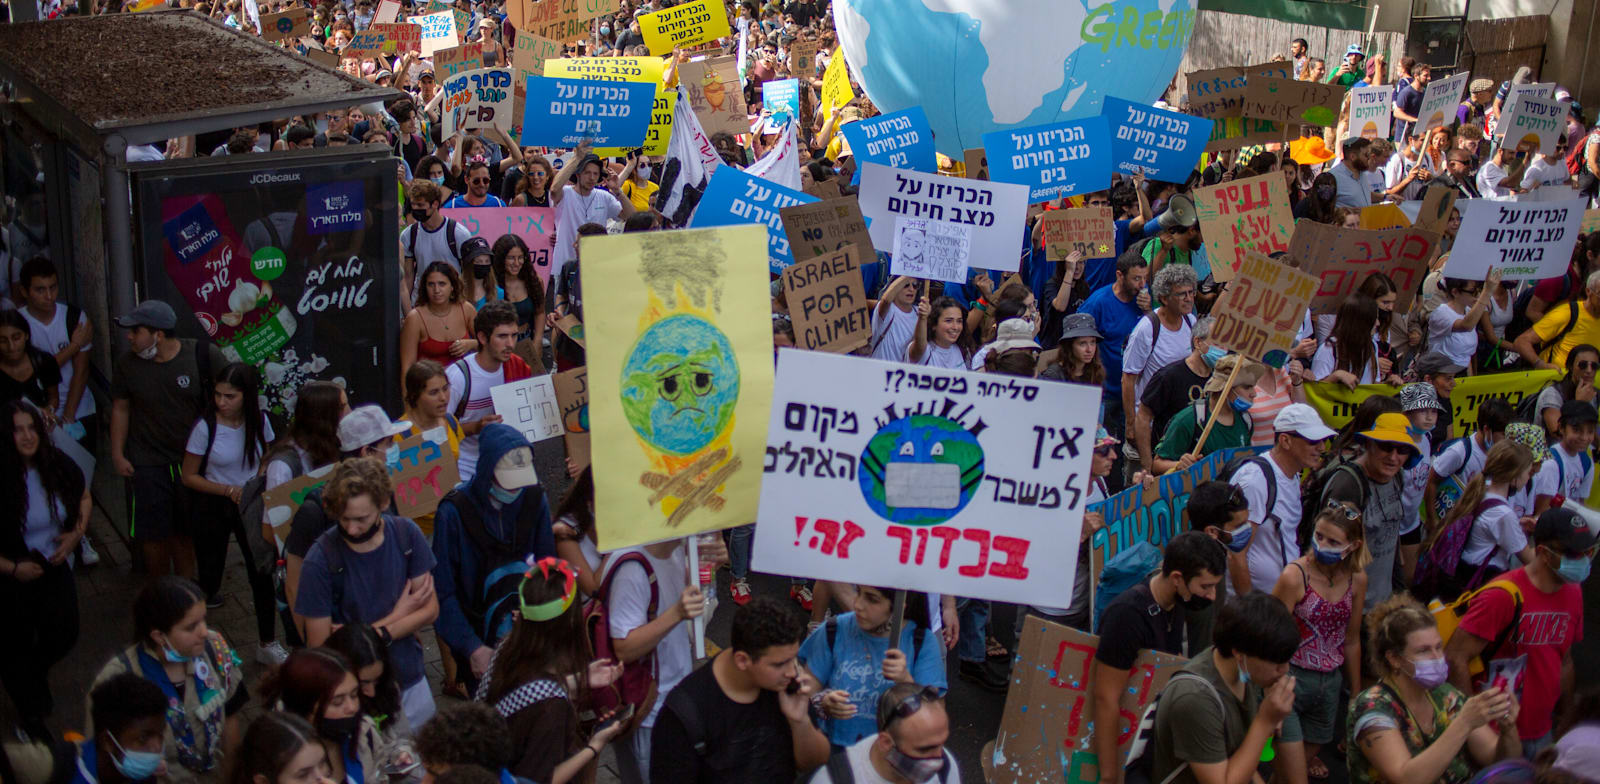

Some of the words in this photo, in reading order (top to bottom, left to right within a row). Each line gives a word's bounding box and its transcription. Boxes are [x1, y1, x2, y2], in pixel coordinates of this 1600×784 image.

[422, 15, 452, 25] SPEAK
[657, 11, 671, 23] על
[672, 4, 706, 20] הכריזו
[689, 13, 711, 26] מצב
[658, 20, 686, 34] חירום
[670, 27, 704, 42] ביבשה
[471, 70, 511, 89] כדור
[611, 67, 641, 75] מצב
[556, 81, 579, 99] על
[582, 86, 629, 101] הכריזו
[1432, 83, 1451, 96] עתיד
[1452, 79, 1462, 90] יש
[475, 88, 506, 103] יותר
[1358, 92, 1377, 103] עתיד
[1377, 91, 1387, 102] יש
[1426, 91, 1458, 111] לירוקים
[550, 101, 594, 116] חירום
[598, 103, 631, 117] מצב
[1127, 106, 1146, 125] על
[1356, 104, 1386, 119] לירוקים
[1524, 100, 1548, 115] עתיד
[1550, 105, 1562, 117] יש
[860, 124, 879, 139] על
[878, 116, 912, 135] הכריזו
[1149, 111, 1189, 135] הכריזו
[1516, 115, 1557, 132] לירוקים
[896, 131, 919, 148] מצב
[1011, 132, 1036, 150] על
[1038, 126, 1084, 148] הכריזו
[1116, 124, 1157, 146] חירום
[1159, 132, 1187, 151] מצב
[867, 136, 897, 156] חירום
[1059, 144, 1090, 162] מצב
[1133, 146, 1158, 163] בים
[889, 152, 908, 168] בים
[1011, 149, 1055, 169] חירום
[250, 173, 301, 185] JCDecaux
[896, 174, 922, 194] על
[1040, 167, 1067, 184] בים
[745, 179, 772, 201] על
[928, 182, 993, 206] הכריזו
[341, 211, 361, 222] מלח
[730, 198, 783, 231] חירום
[888, 196, 944, 221] חירום
[950, 206, 995, 227] מצב
[1498, 206, 1521, 224] על
[1523, 208, 1568, 224] הכריזו
[311, 214, 339, 228] הארץ
[506, 213, 545, 235] אין
[1231, 215, 1270, 245] שלא
[199, 229, 218, 247] מלח
[802, 228, 823, 242] NO
[1485, 229, 1531, 244] חירום
[1534, 227, 1565, 243] מצב
[178, 237, 202, 259] הארץ
[1345, 233, 1429, 264] מצב
[1499, 247, 1544, 262] באוויר
[254, 257, 283, 270] חדש
[306, 261, 332, 284] עם
[334, 255, 363, 279] מלח
[1284, 271, 1315, 301] אני
[297, 278, 374, 315] טוויסט
[802, 285, 854, 321] FOR
[1229, 277, 1302, 332] נשנה
[1211, 312, 1269, 358] העולם
[978, 379, 1040, 402] סליחה
[784, 401, 860, 443] מקום
[1033, 425, 1084, 469] אין
[985, 473, 1081, 512] למשבר
[793, 516, 865, 559] זה!
[887, 524, 1031, 580] בכדור
[1511, 612, 1570, 645] NIKE
